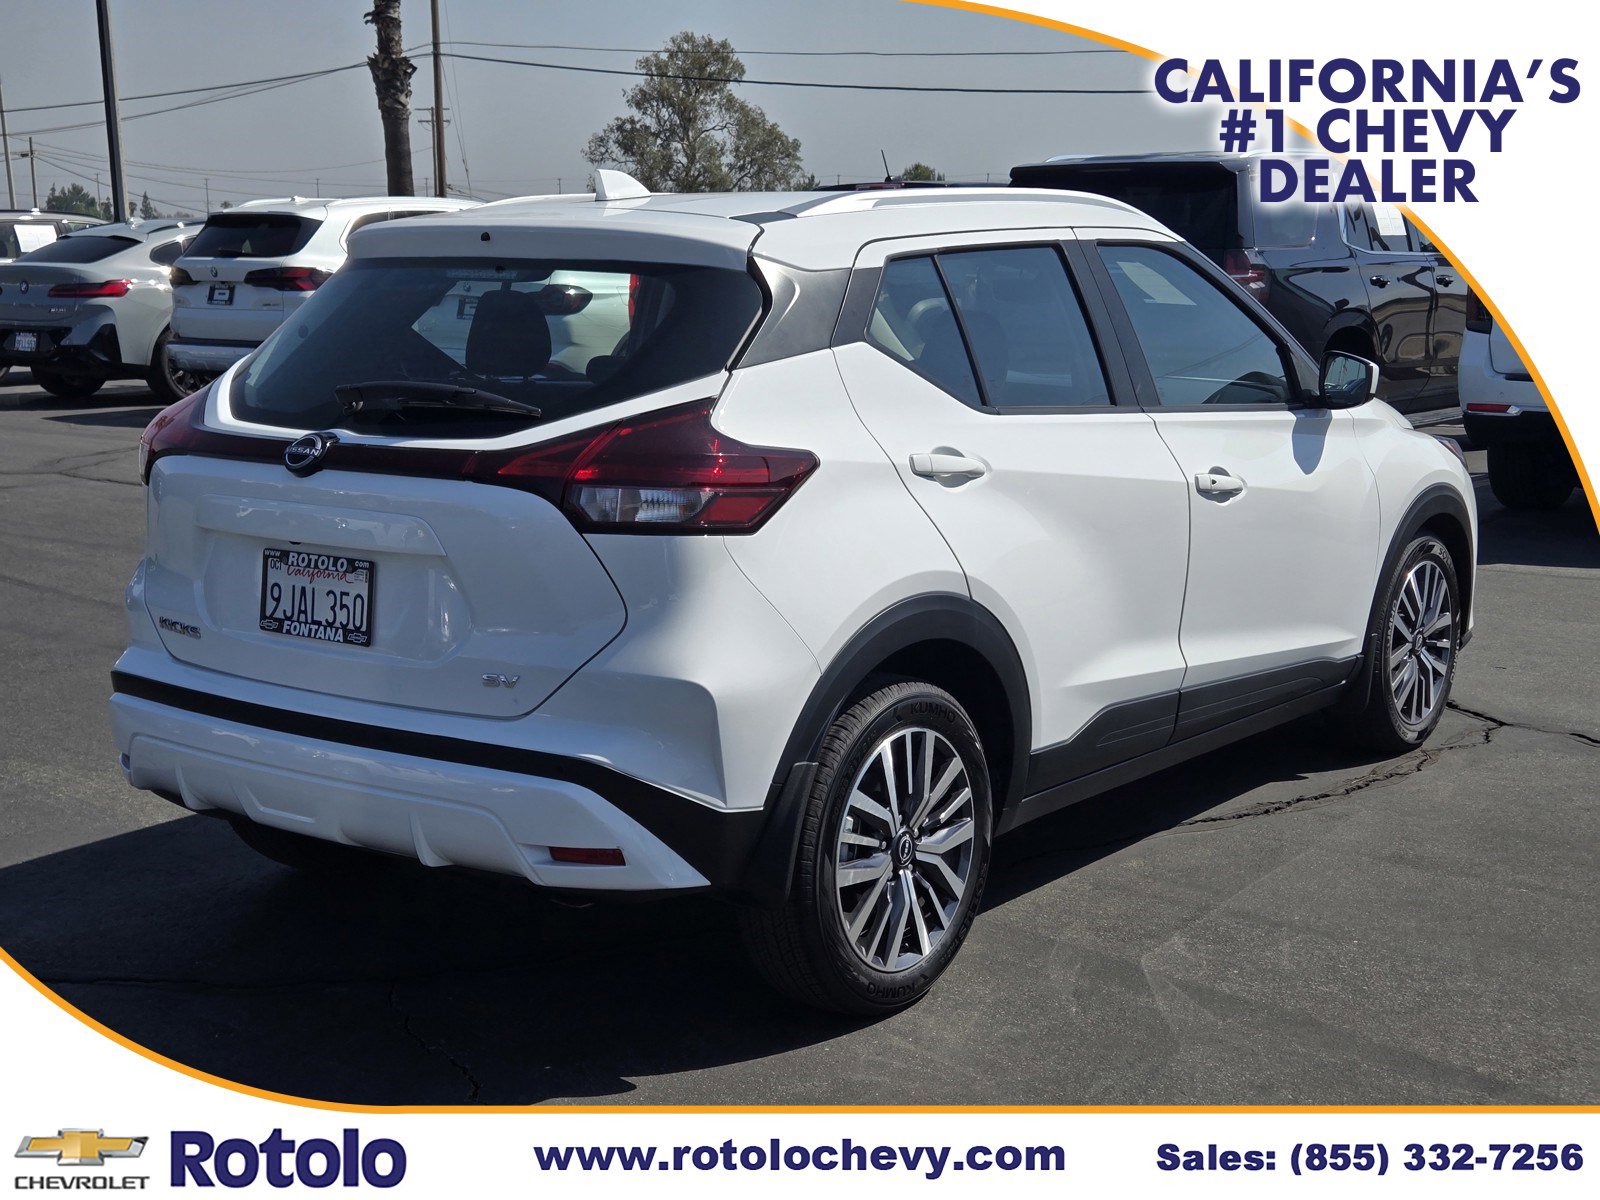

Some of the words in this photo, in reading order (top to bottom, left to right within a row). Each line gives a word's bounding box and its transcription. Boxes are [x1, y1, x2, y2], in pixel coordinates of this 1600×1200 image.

[286, 446, 322, 457] NISSAN
[288, 553, 347, 572] ROTOLO
[265, 582, 365, 632] 9JAL350
[282, 621, 343, 642] FONTANA
[482, 672, 521, 689] SV
